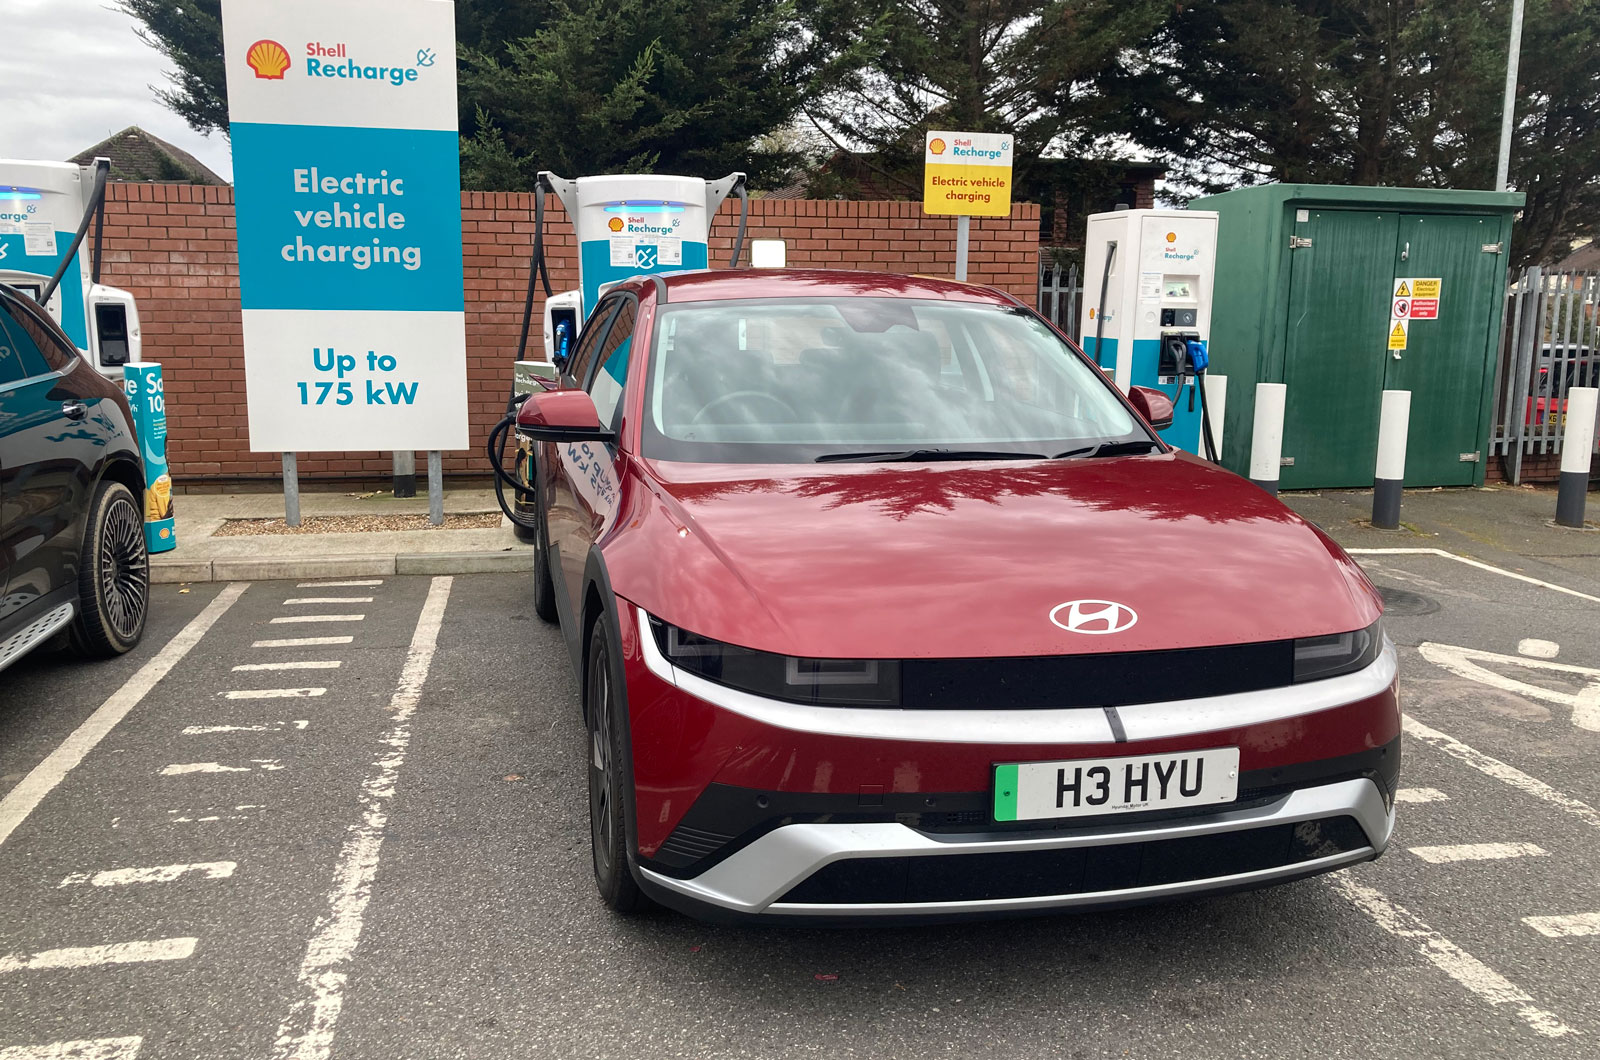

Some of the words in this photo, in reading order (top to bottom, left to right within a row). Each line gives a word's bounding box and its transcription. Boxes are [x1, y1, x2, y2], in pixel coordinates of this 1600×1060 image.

[306, 42, 346, 57] Shell
[306, 58, 418, 86] Recharge
[953, 147, 1001, 159] Recharge
[294, 167, 404, 195] Electric
[932, 176, 968, 186] Electric
[970, 177, 1005, 187] vehicle
[945, 190, 991, 203] charging
[294, 202, 405, 229] vehicle
[628, 224, 673, 235] Recharge
[281, 236, 421, 270] charging
[313, 348, 356, 378] Up
[366, 351, 397, 372] to
[297, 382, 354, 406] 175
[366, 380, 419, 405] kW
[1055, 766, 1111, 809] H3
[1123, 757, 1205, 803] HYU
